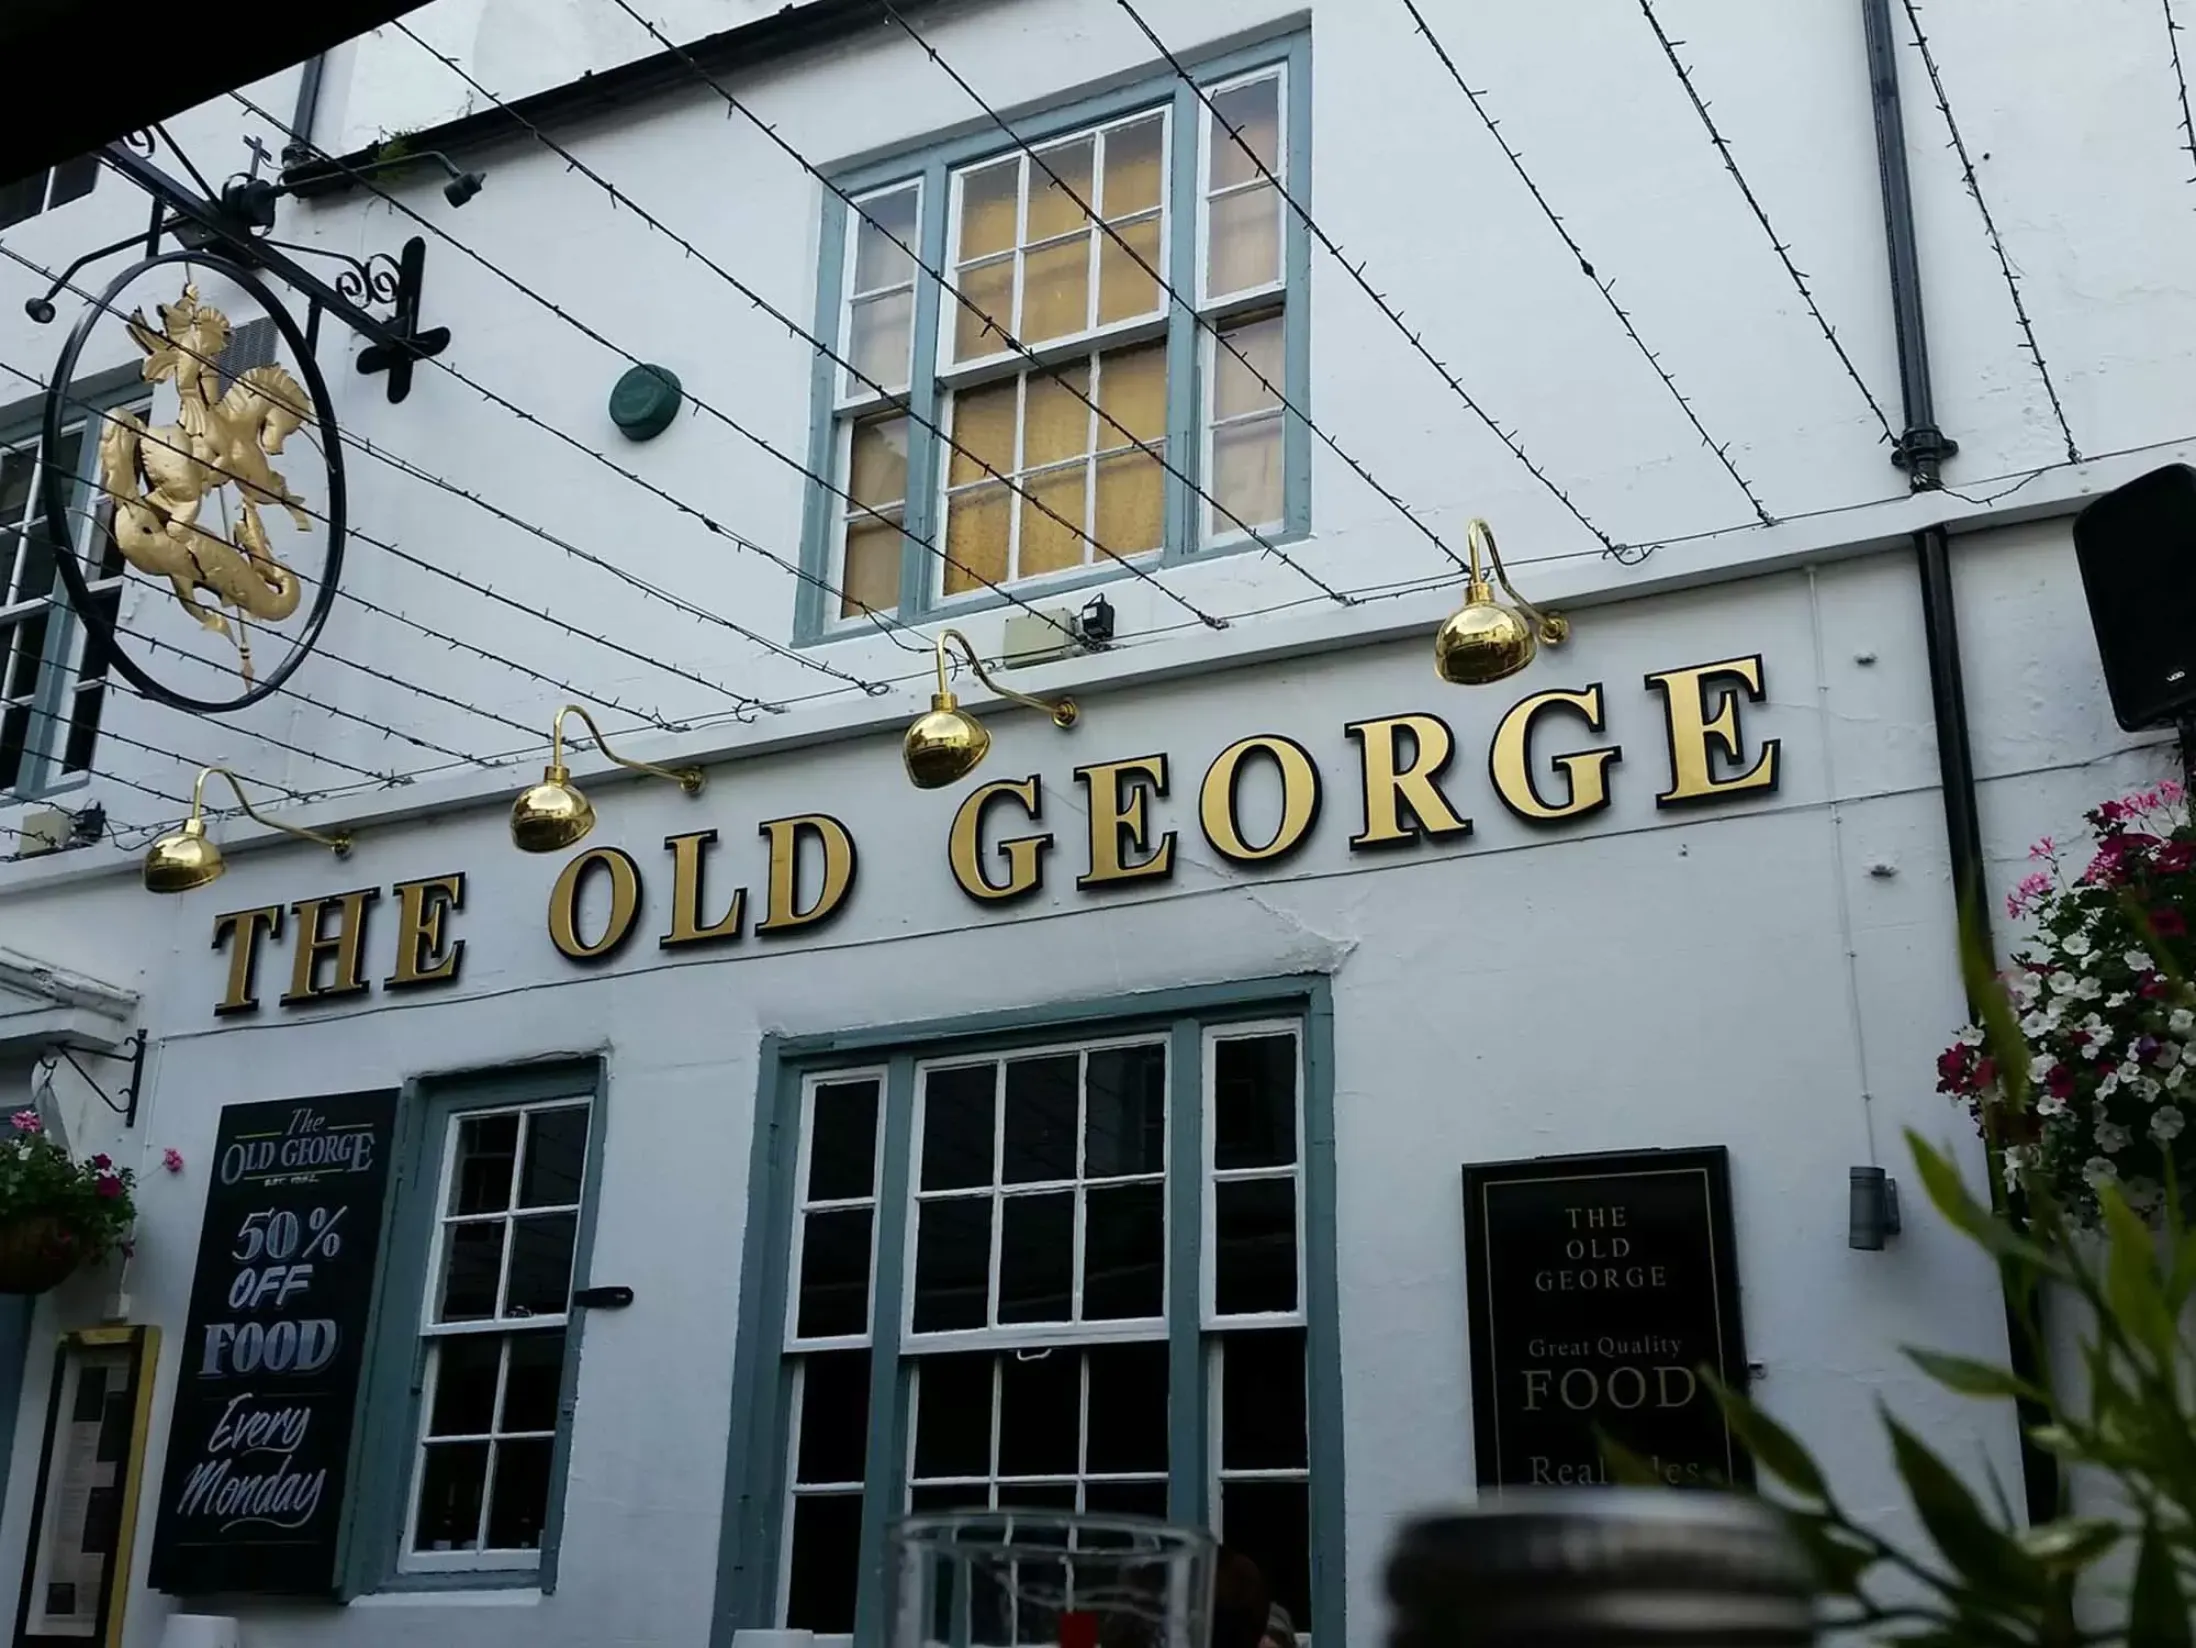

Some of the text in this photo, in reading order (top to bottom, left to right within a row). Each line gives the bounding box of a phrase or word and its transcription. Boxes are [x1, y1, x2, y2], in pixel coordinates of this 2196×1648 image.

[211, 654, 1782, 1017] THE OLD GEORGE
[286, 1108, 325, 1136] The
[221, 1132, 375, 1184] OLD GEORGE
[1565, 1206, 1627, 1229] THE
[1566, 1237, 1630, 1259] OLD
[228, 1264, 313, 1309] OFF
[1535, 1266, 1667, 1292] GEORGE
[197, 1319, 337, 1378] FOOD
[1529, 1334, 1682, 1358] Great Quality
[1521, 1366, 1697, 1411] FOOD
[208, 1393, 311, 1456] Every
[1529, 1455, 1608, 1485] Real
[177, 1455, 326, 1532] Monday
